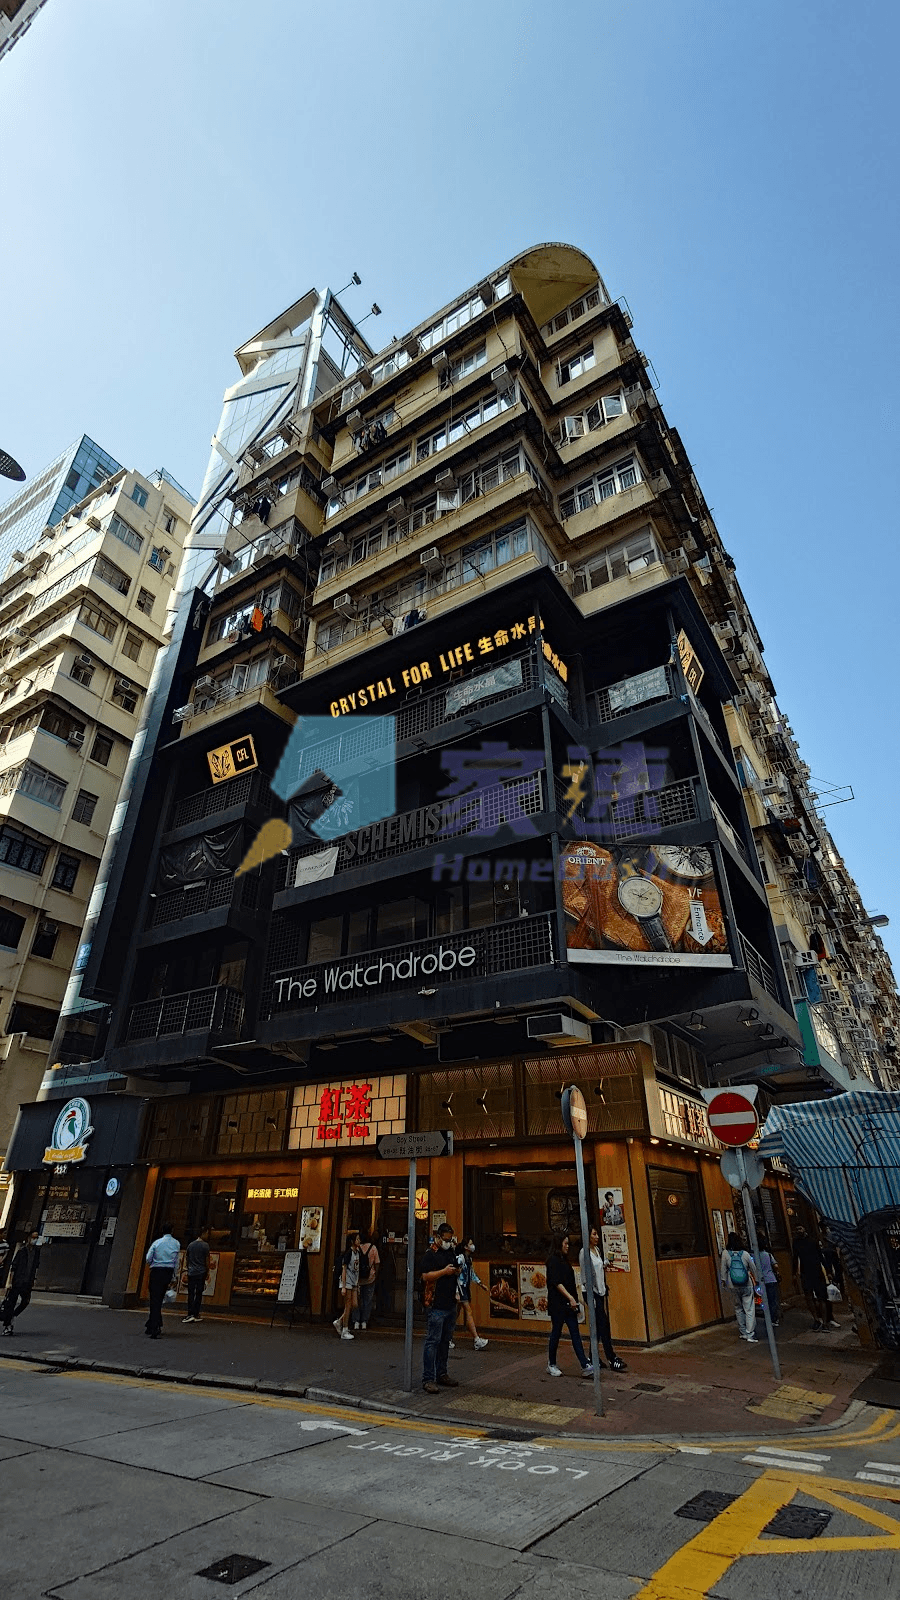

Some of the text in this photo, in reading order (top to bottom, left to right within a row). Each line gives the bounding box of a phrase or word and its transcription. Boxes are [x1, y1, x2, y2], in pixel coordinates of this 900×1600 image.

[330, 677, 396, 718] CRYSTAL
[402, 661, 432, 688] FOR
[439, 642, 474, 672] LIFE
[453, 676, 496, 700] 生命水晶
[236, 748, 249, 762] CFL
[344, 797, 462, 860] SCHEMISM
[568, 857, 606, 866] ORIENT
[687, 888, 703, 898] 1/F
[694, 907, 705, 941] Entrance
[616, 953, 681, 964] The Watchdrobe
[275, 945, 476, 1003] The Watchdrobe
[318, 1083, 372, 1122] 紅茶
[316, 1122, 370, 1140] Red Tea
[408, 1135, 426, 1143] Street
[347, 1440, 590, 1480] LOOK RIGHT
